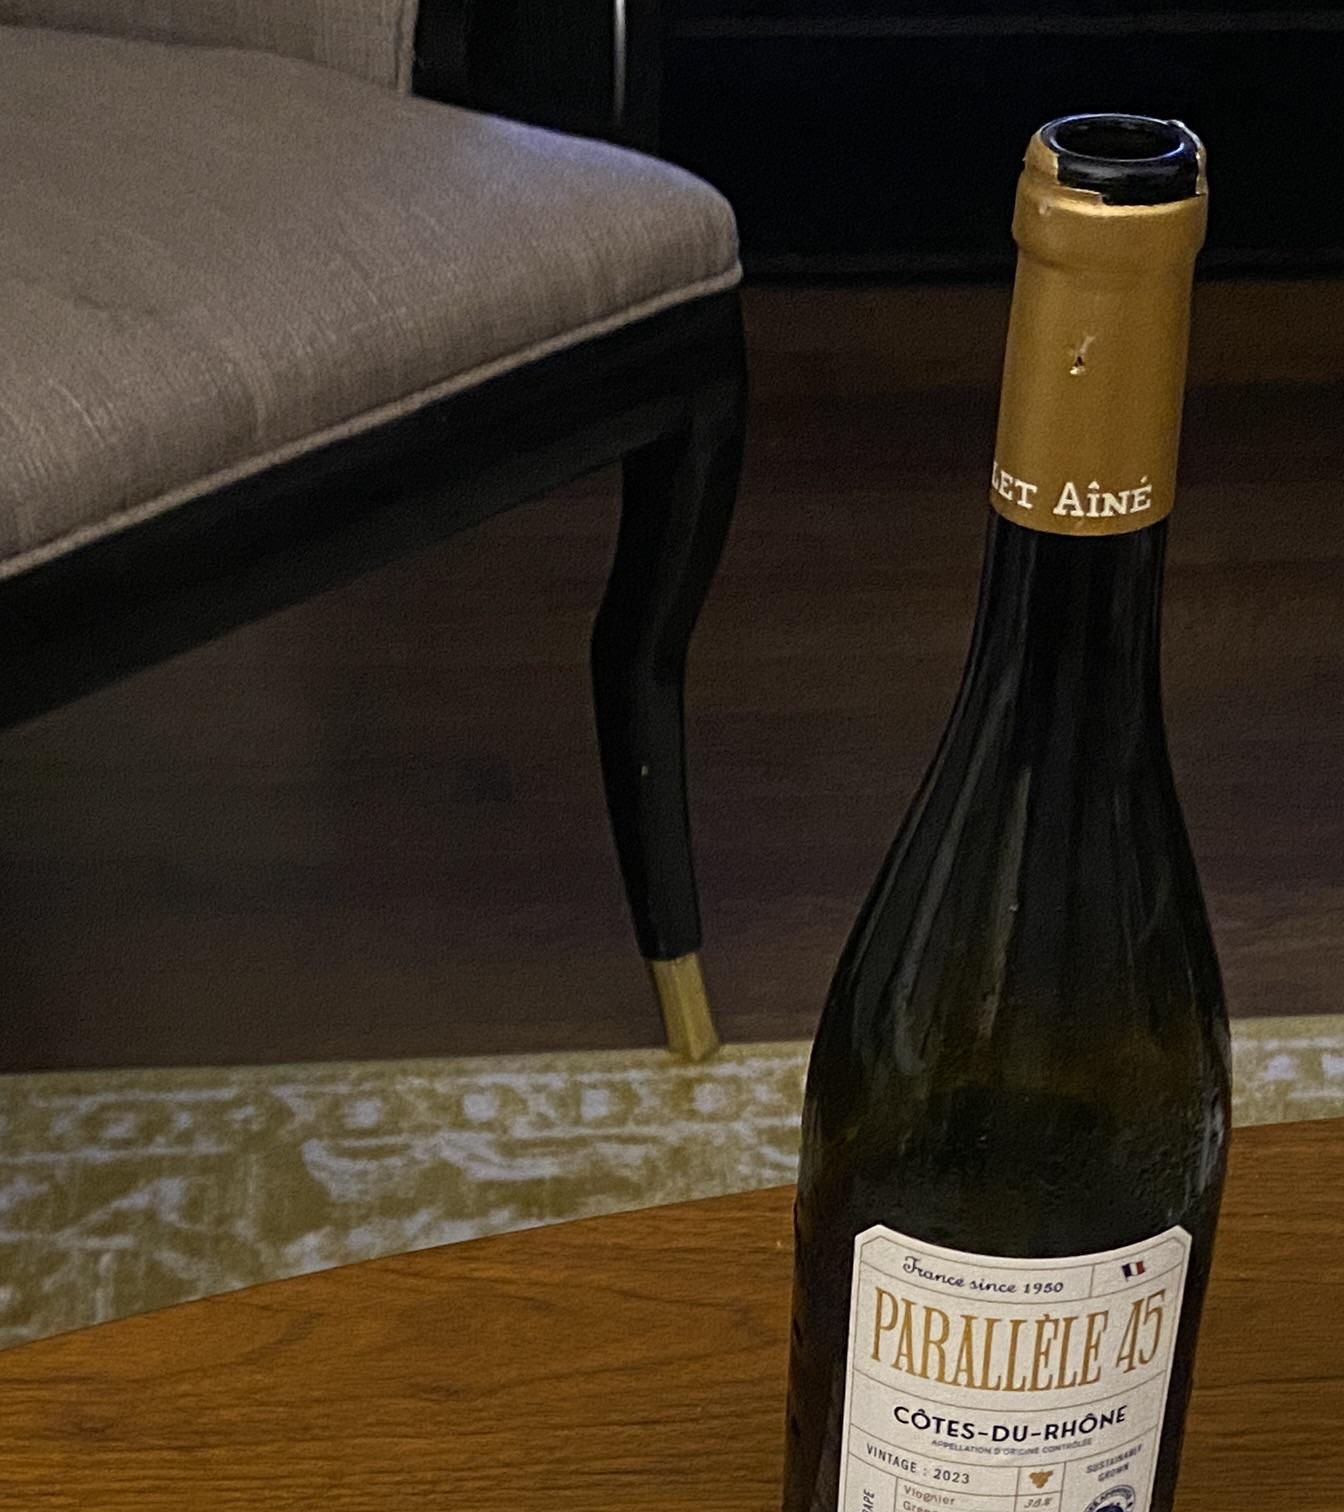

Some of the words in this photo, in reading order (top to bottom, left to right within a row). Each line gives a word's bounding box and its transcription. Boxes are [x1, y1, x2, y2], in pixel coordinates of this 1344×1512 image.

[902, 1255, 966, 1288] France
[969, 1278, 1016, 1294] since
[1023, 1282, 1064, 1294] 1950
[870, 1286, 1109, 1392] PARALLÈLE
[1115, 1288, 1167, 1374] 45
[893, 1404, 1128, 1442] CÔTES-DU-RHÔNE
[866, 1442, 918, 1473] VINTAGE
[932, 1468, 970, 1485] 2023
[903, 1484, 956, 1505] Viognier
